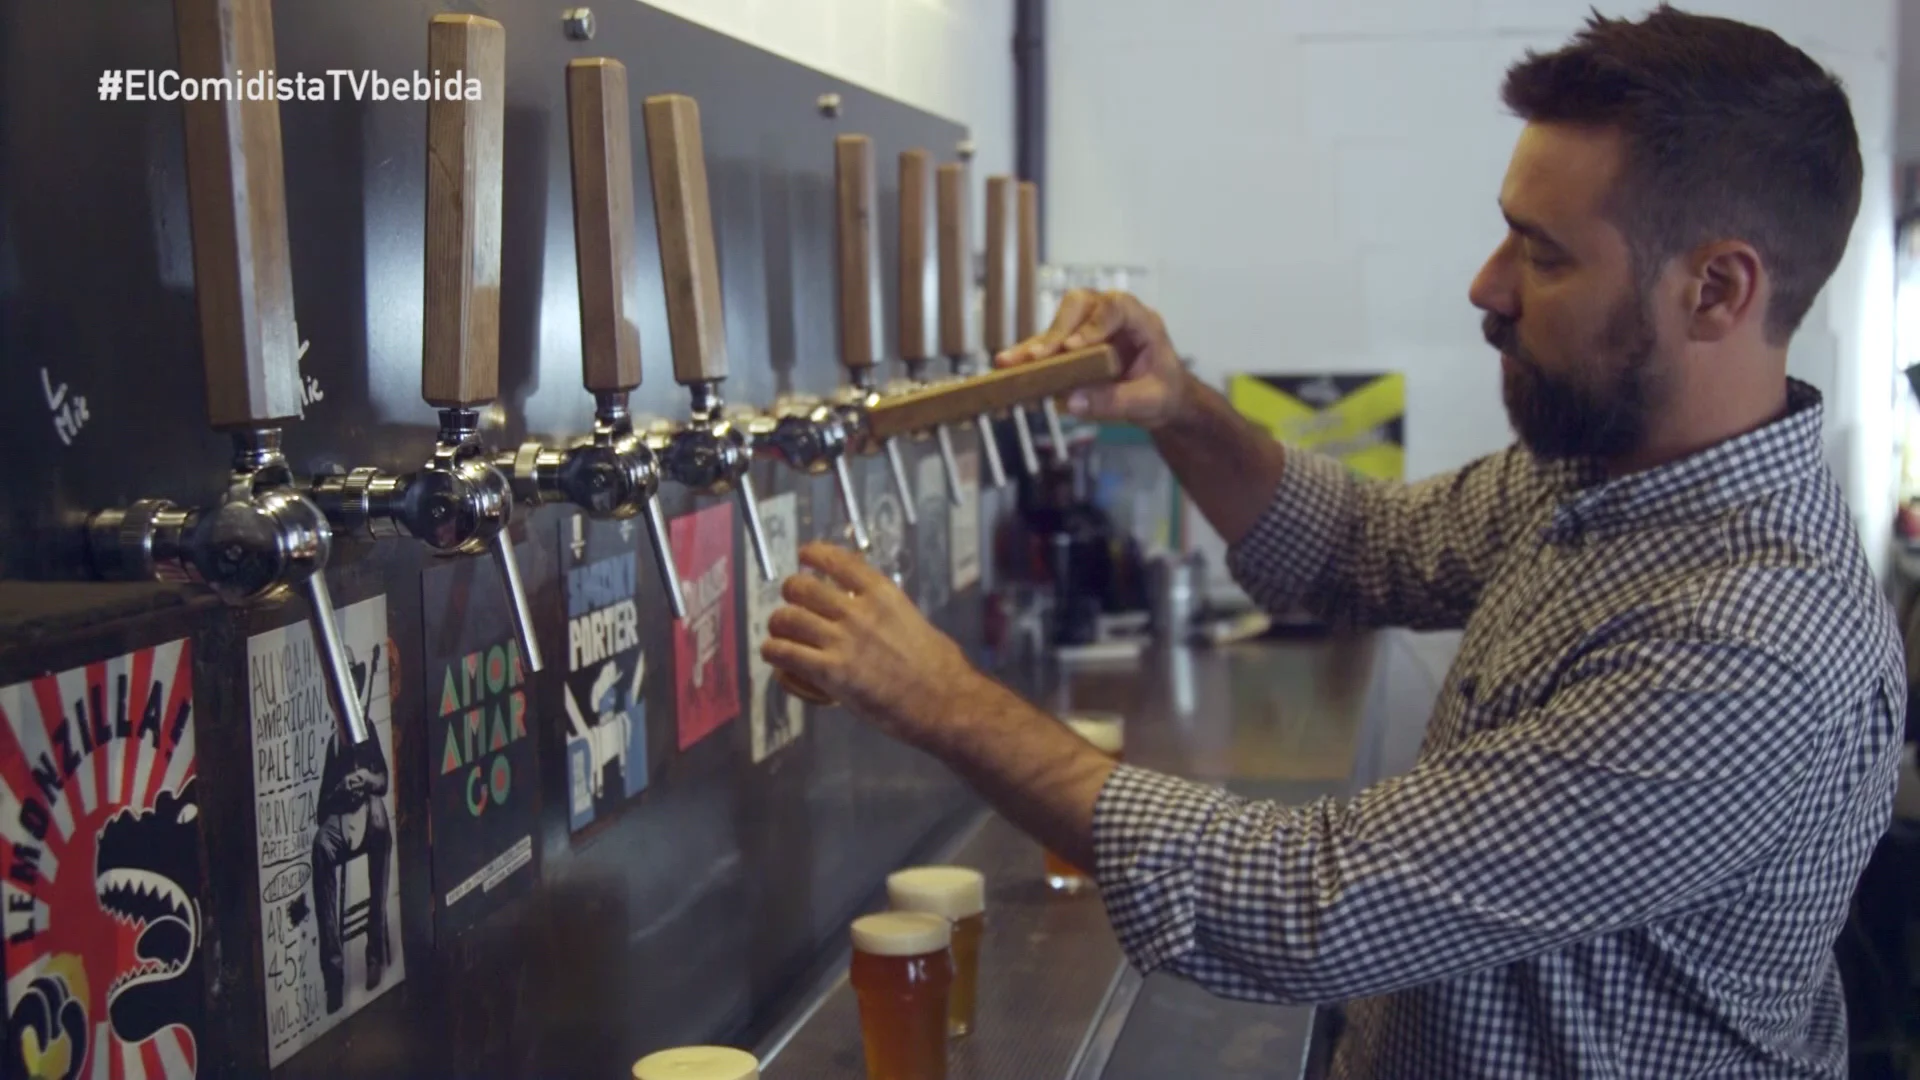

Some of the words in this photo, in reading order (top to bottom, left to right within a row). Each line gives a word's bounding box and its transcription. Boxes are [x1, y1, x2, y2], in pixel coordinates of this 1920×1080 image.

[568, 597, 639, 672] PORTER
[258, 738, 291, 784] PALE
[441, 689, 528, 776] AMAR
[466, 753, 512, 817] GO
